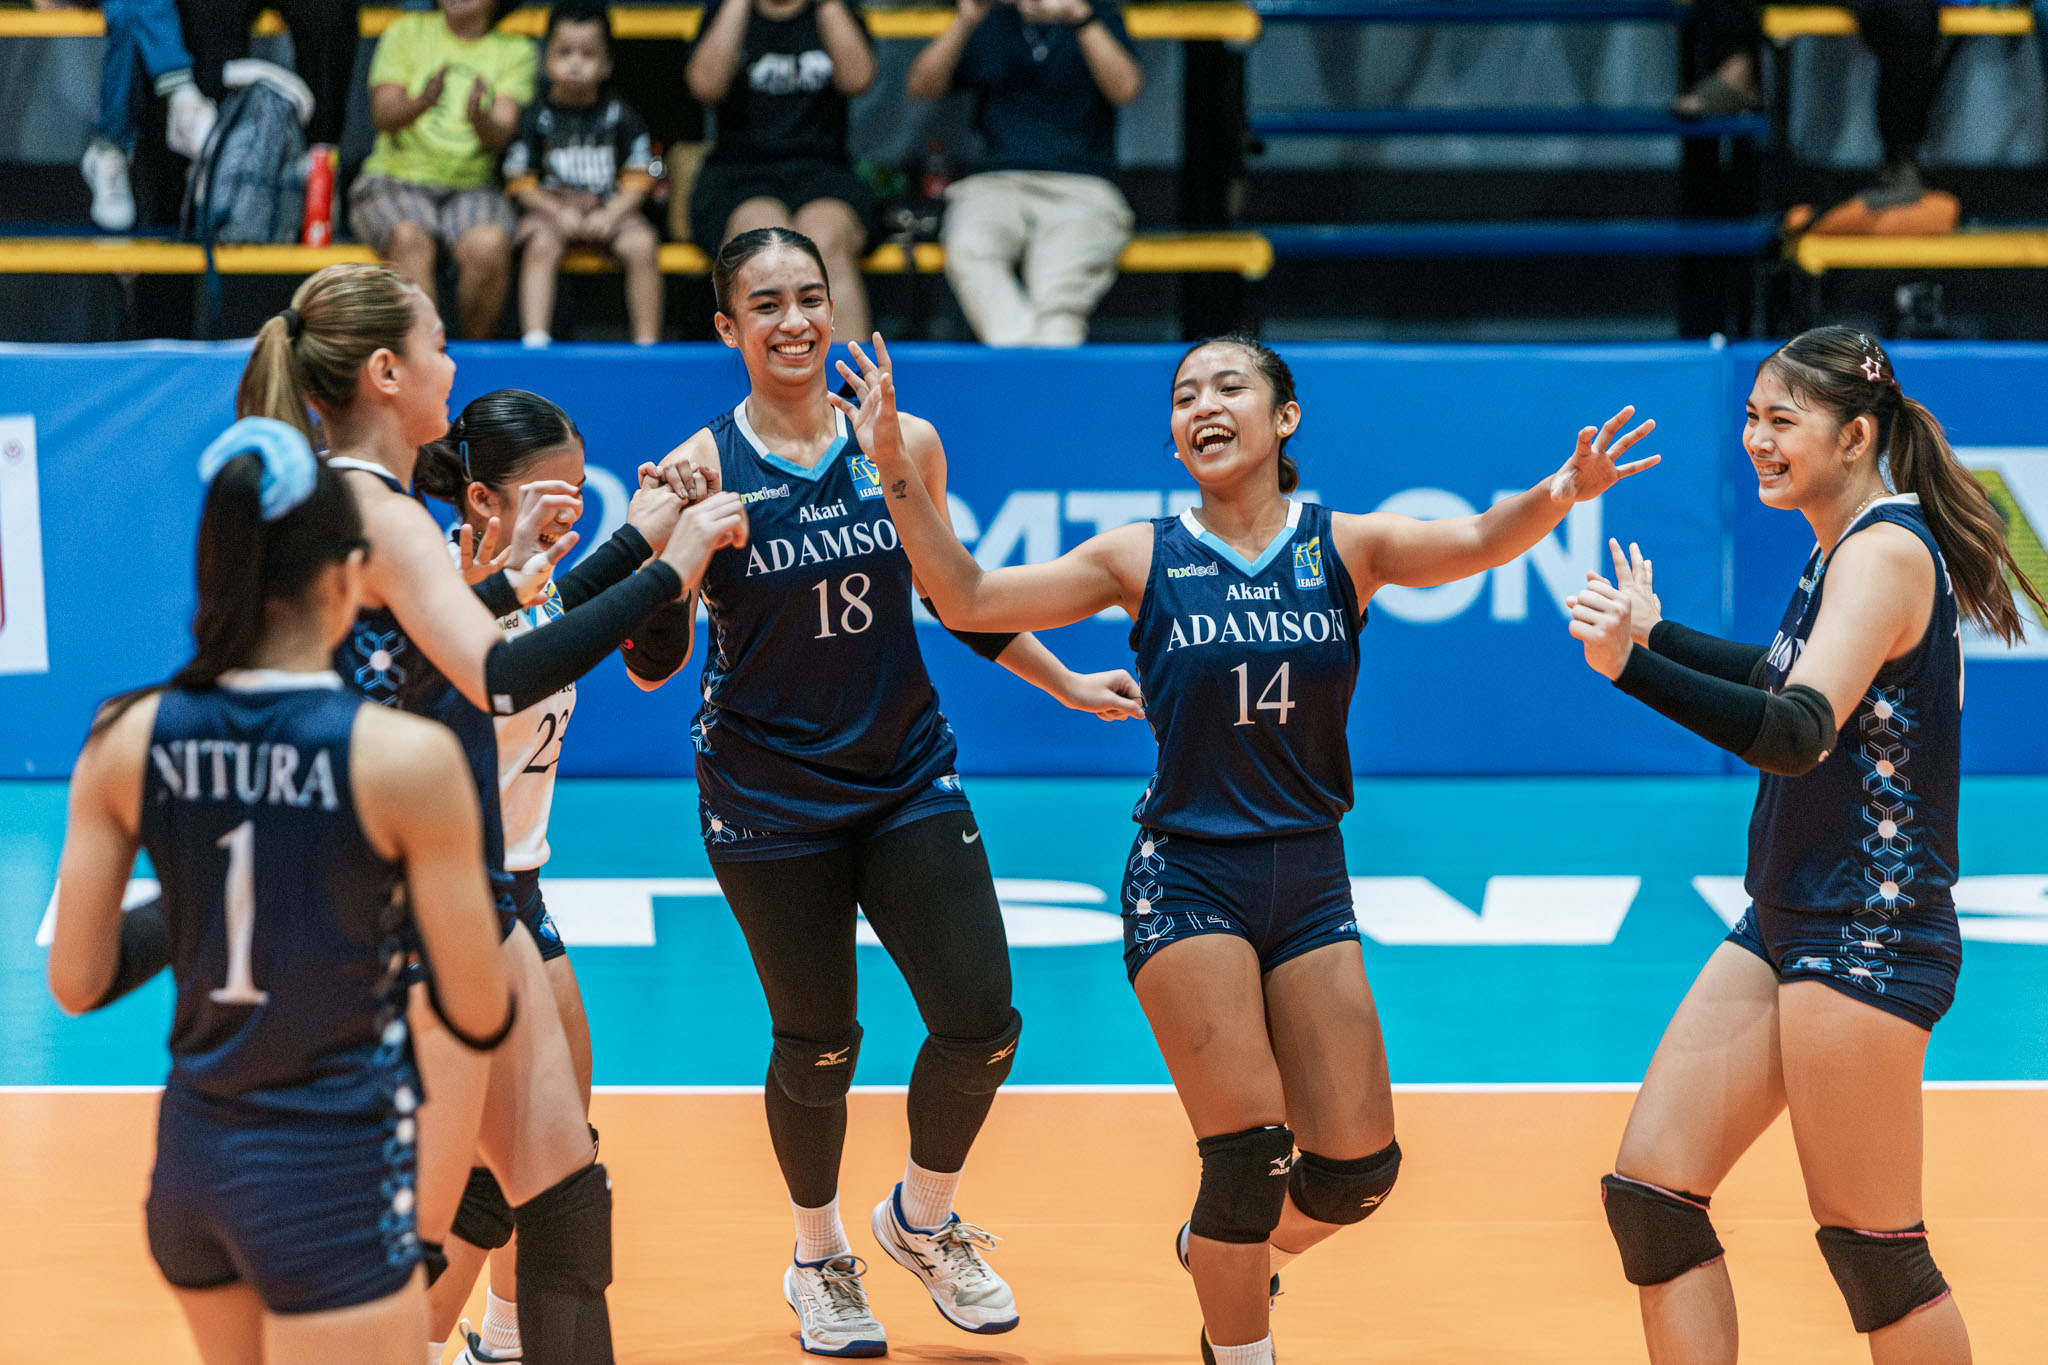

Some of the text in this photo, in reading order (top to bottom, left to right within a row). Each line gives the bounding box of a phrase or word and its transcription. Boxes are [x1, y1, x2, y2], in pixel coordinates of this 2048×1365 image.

[741, 484, 790, 504] nxled
[859, 486, 883, 498] LEAGU
[799, 498, 848, 524] Akari
[745, 518, 903, 577] ADAMSO
[1168, 561, 1219, 578] nxled
[1297, 575, 1324, 588] LEAGUE
[811, 572, 873, 639] 18
[1226, 582, 1281, 601] Akari
[1167, 608, 1346, 652] ADAMSON
[1230, 661, 1296, 726] 14
[150, 739, 340, 811] NITURA
[208, 819, 270, 1005] 1
